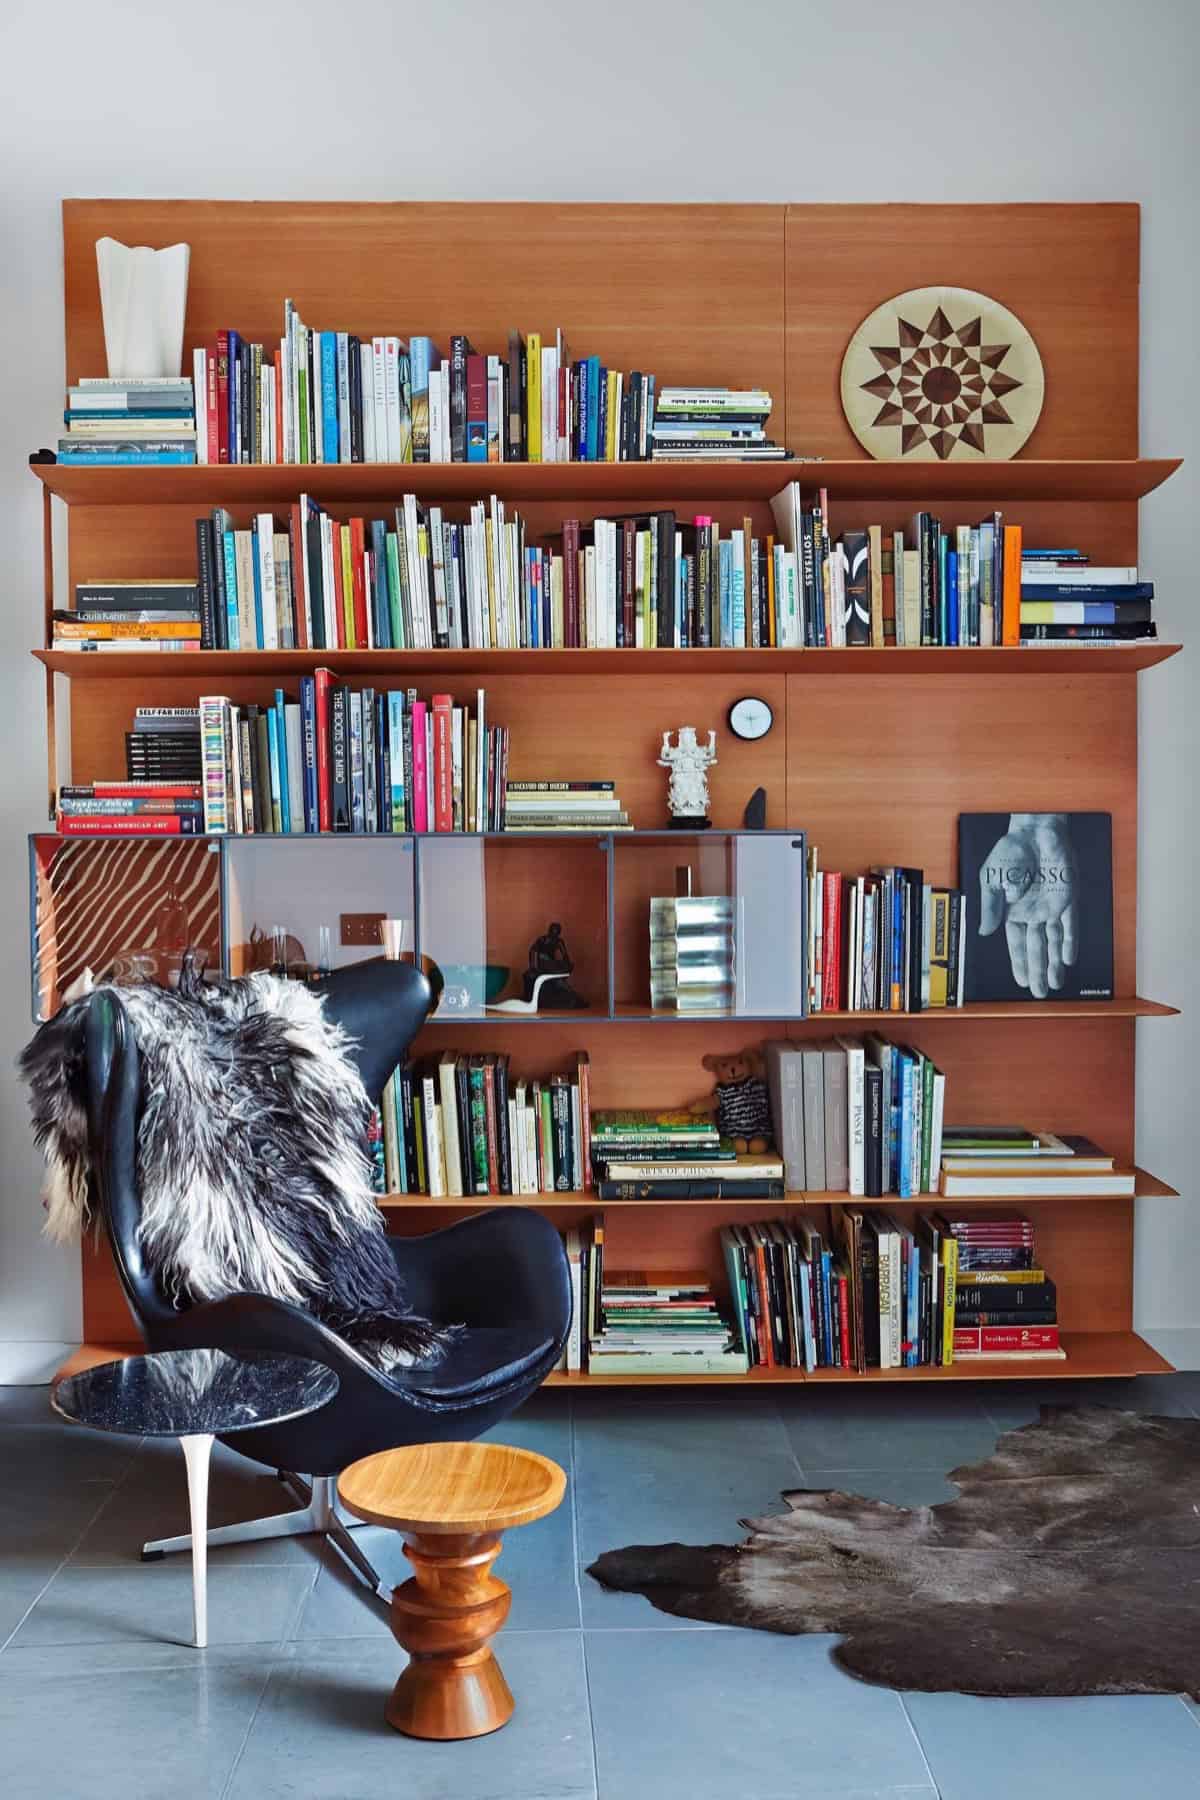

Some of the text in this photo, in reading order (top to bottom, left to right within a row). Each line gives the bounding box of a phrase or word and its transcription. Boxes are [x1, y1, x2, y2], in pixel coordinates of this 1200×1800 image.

[803, 535, 813, 586] SOTTSASS
[733, 569, 744, 630] MODERN
[334, 690, 343, 709] THE
[334, 711, 343, 742] ROOTS
[335, 743, 344, 758] OF
[986, 866, 1074, 884] PICASSO
[946, 1276, 954, 1308] DESIGN
[1021, 1330, 1029, 1340] 2
